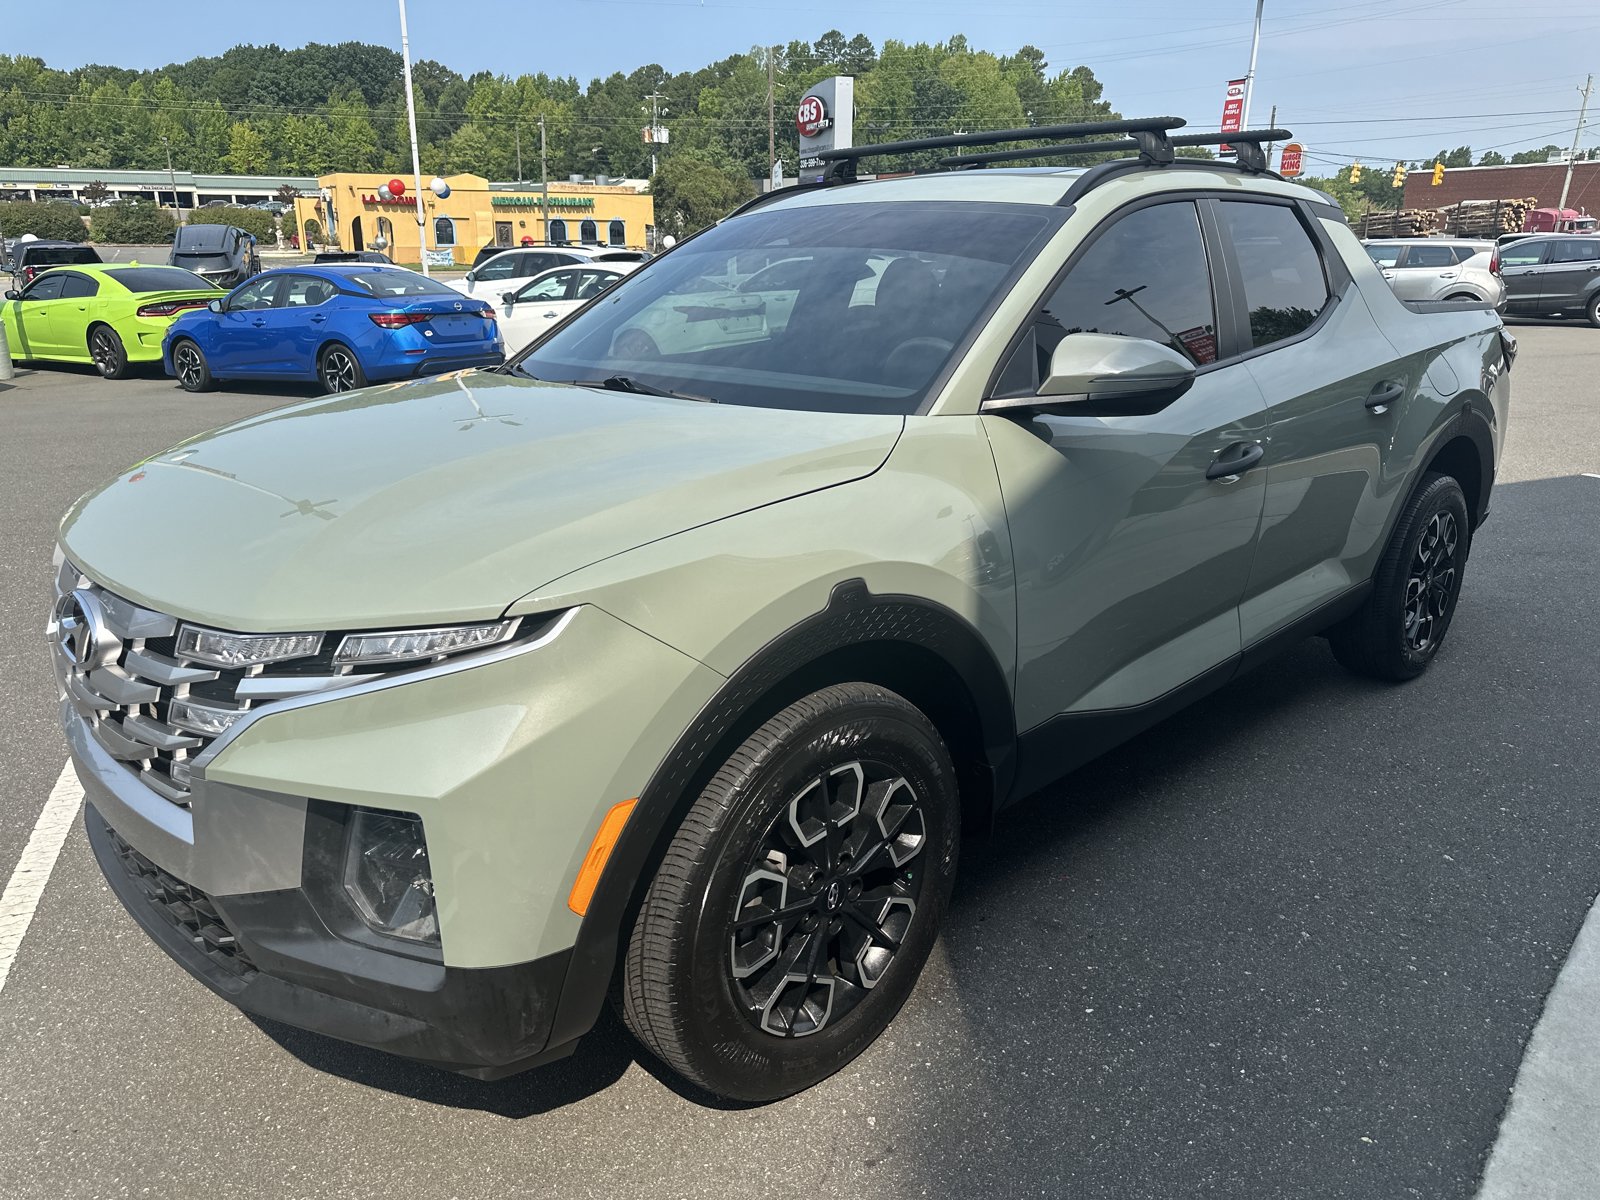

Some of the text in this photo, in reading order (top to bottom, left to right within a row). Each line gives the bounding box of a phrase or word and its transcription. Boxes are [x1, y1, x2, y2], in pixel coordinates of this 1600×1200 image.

[798, 102, 817, 123] CBS
[1282, 153, 1302, 161] BURGER
[1281, 160, 1301, 170] KING
[362, 194, 377, 205] LA
[492, 196, 595, 208] MEXICAN RSTAURANT
